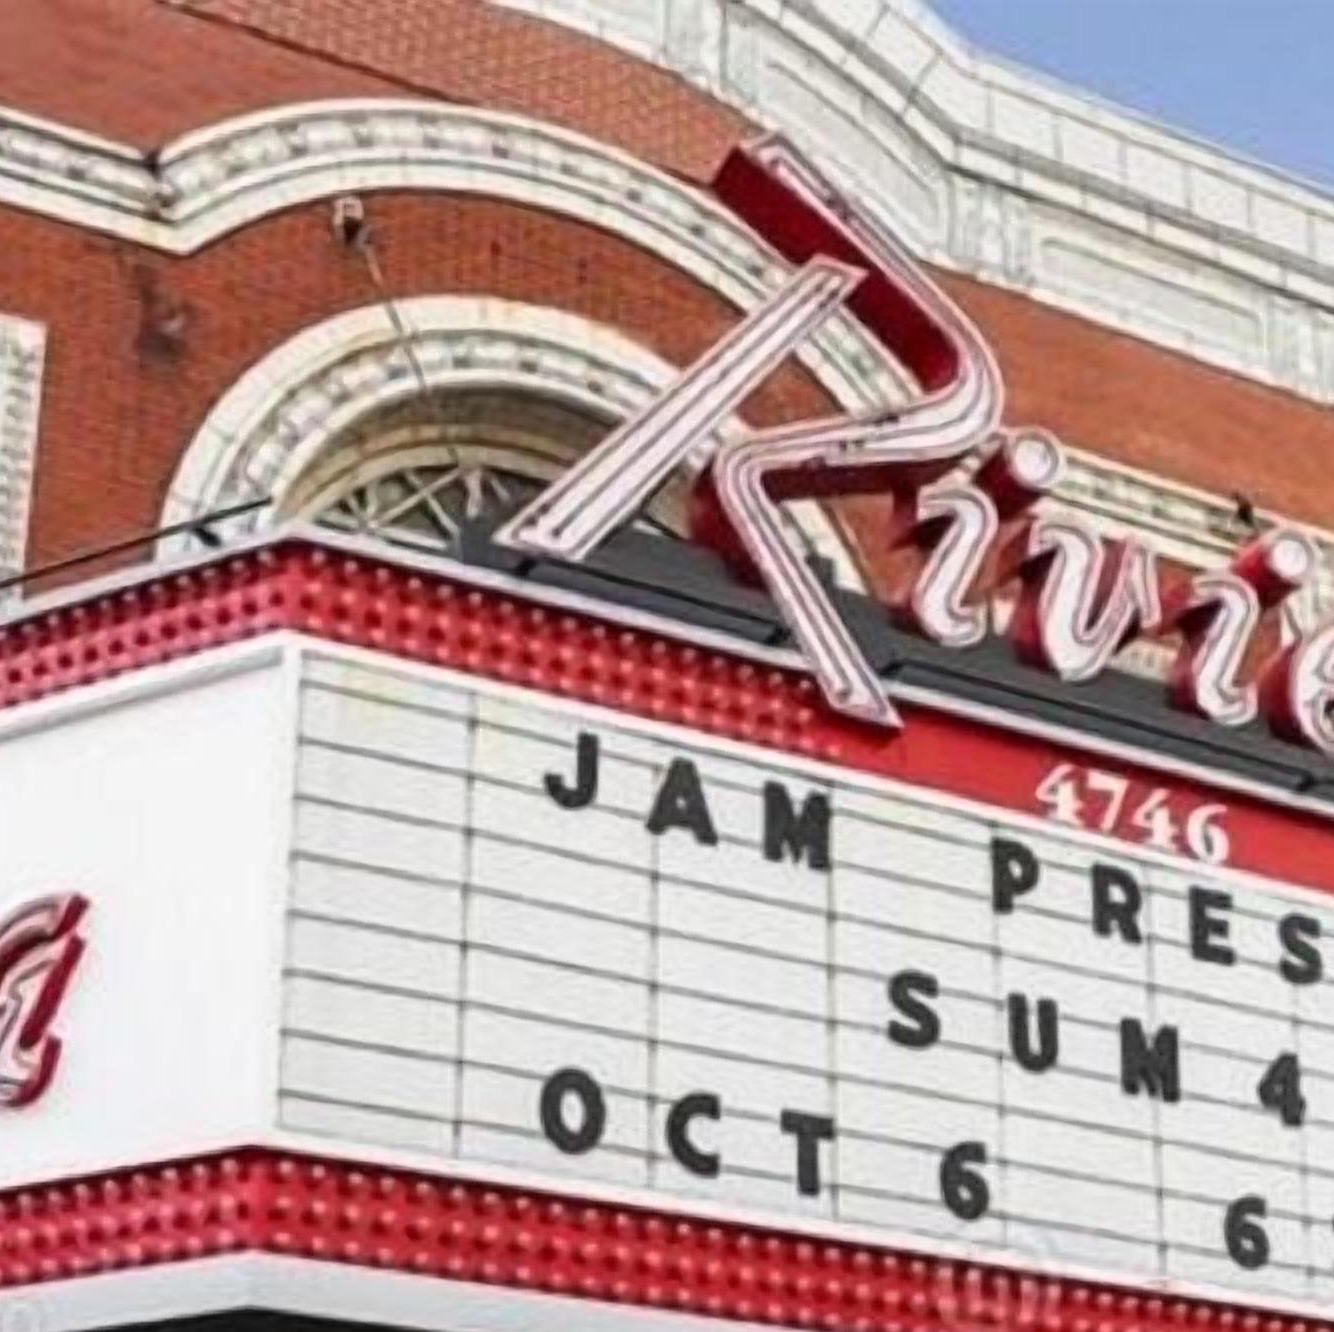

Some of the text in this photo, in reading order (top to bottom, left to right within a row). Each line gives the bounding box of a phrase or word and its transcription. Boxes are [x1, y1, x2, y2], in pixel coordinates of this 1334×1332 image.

[543, 731, 835, 871] JAM
[1035, 763, 1230, 867] 4746
[887, 968, 1181, 1104] SUM
[539, 1067, 835, 1196] OCT
[938, 1140, 991, 1221] 6
